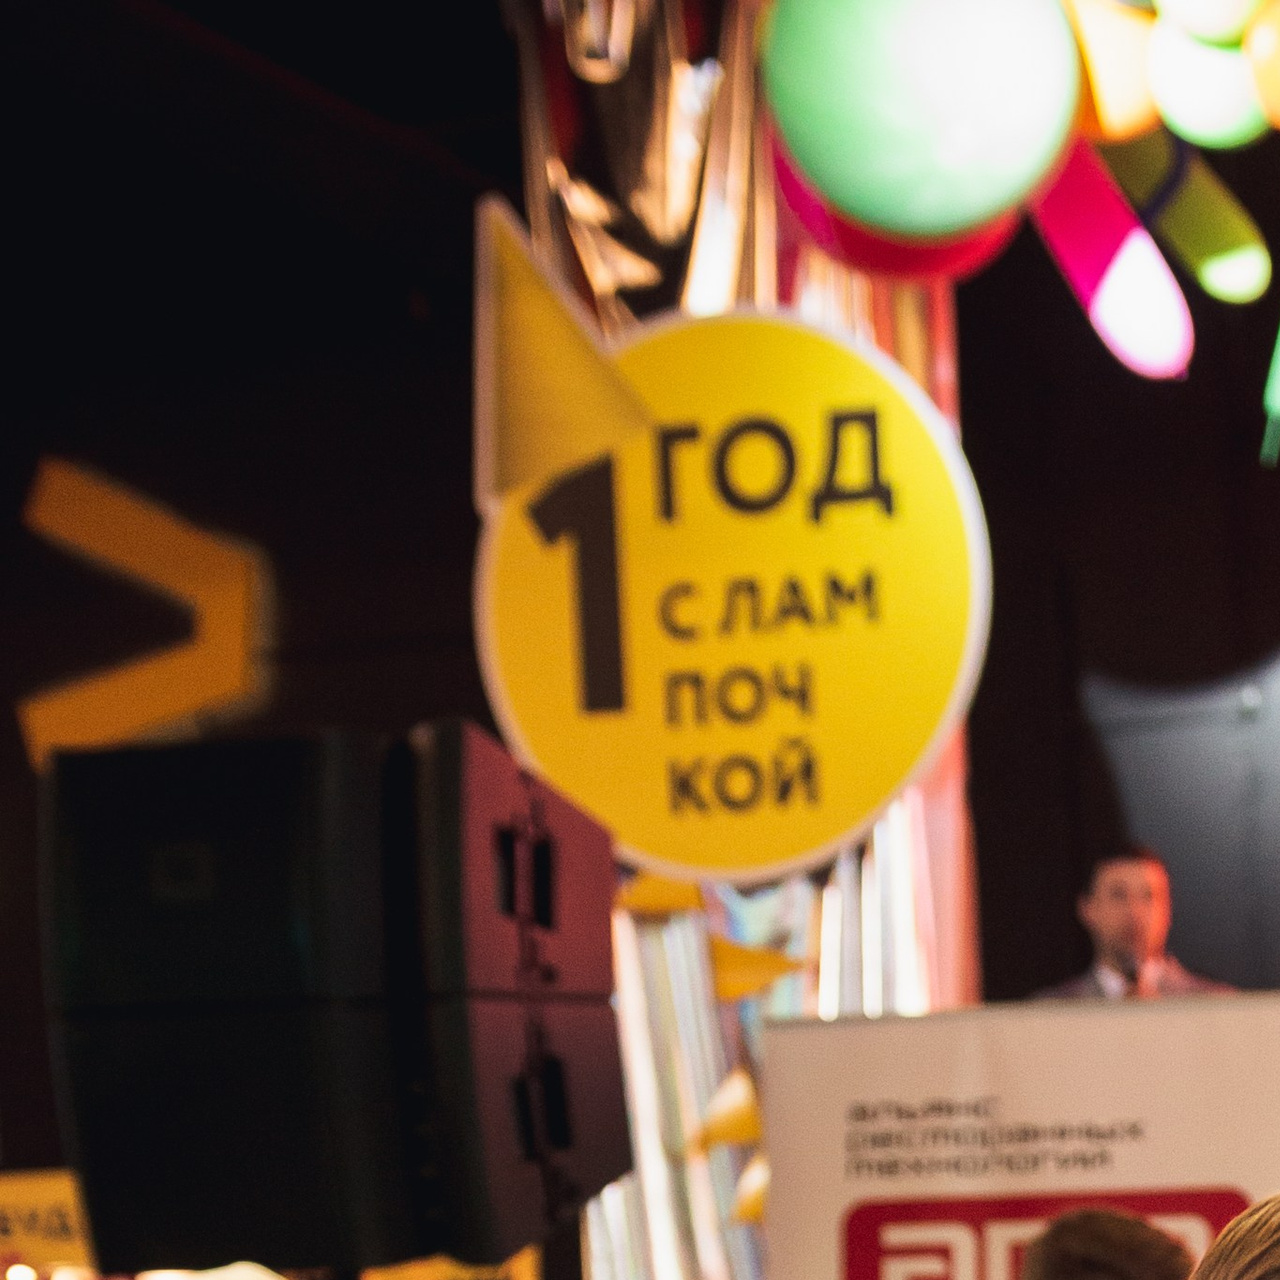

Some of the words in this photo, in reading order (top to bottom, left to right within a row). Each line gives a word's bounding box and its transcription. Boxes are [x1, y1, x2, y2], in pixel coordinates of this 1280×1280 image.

[527, 447, 627, 718] 1
[653, 405, 897, 527] ГОД
[717, 565, 880, 637] ЛАМ
[663, 659, 818, 732] ПОЧ
[664, 735, 824, 818] КОЙ
